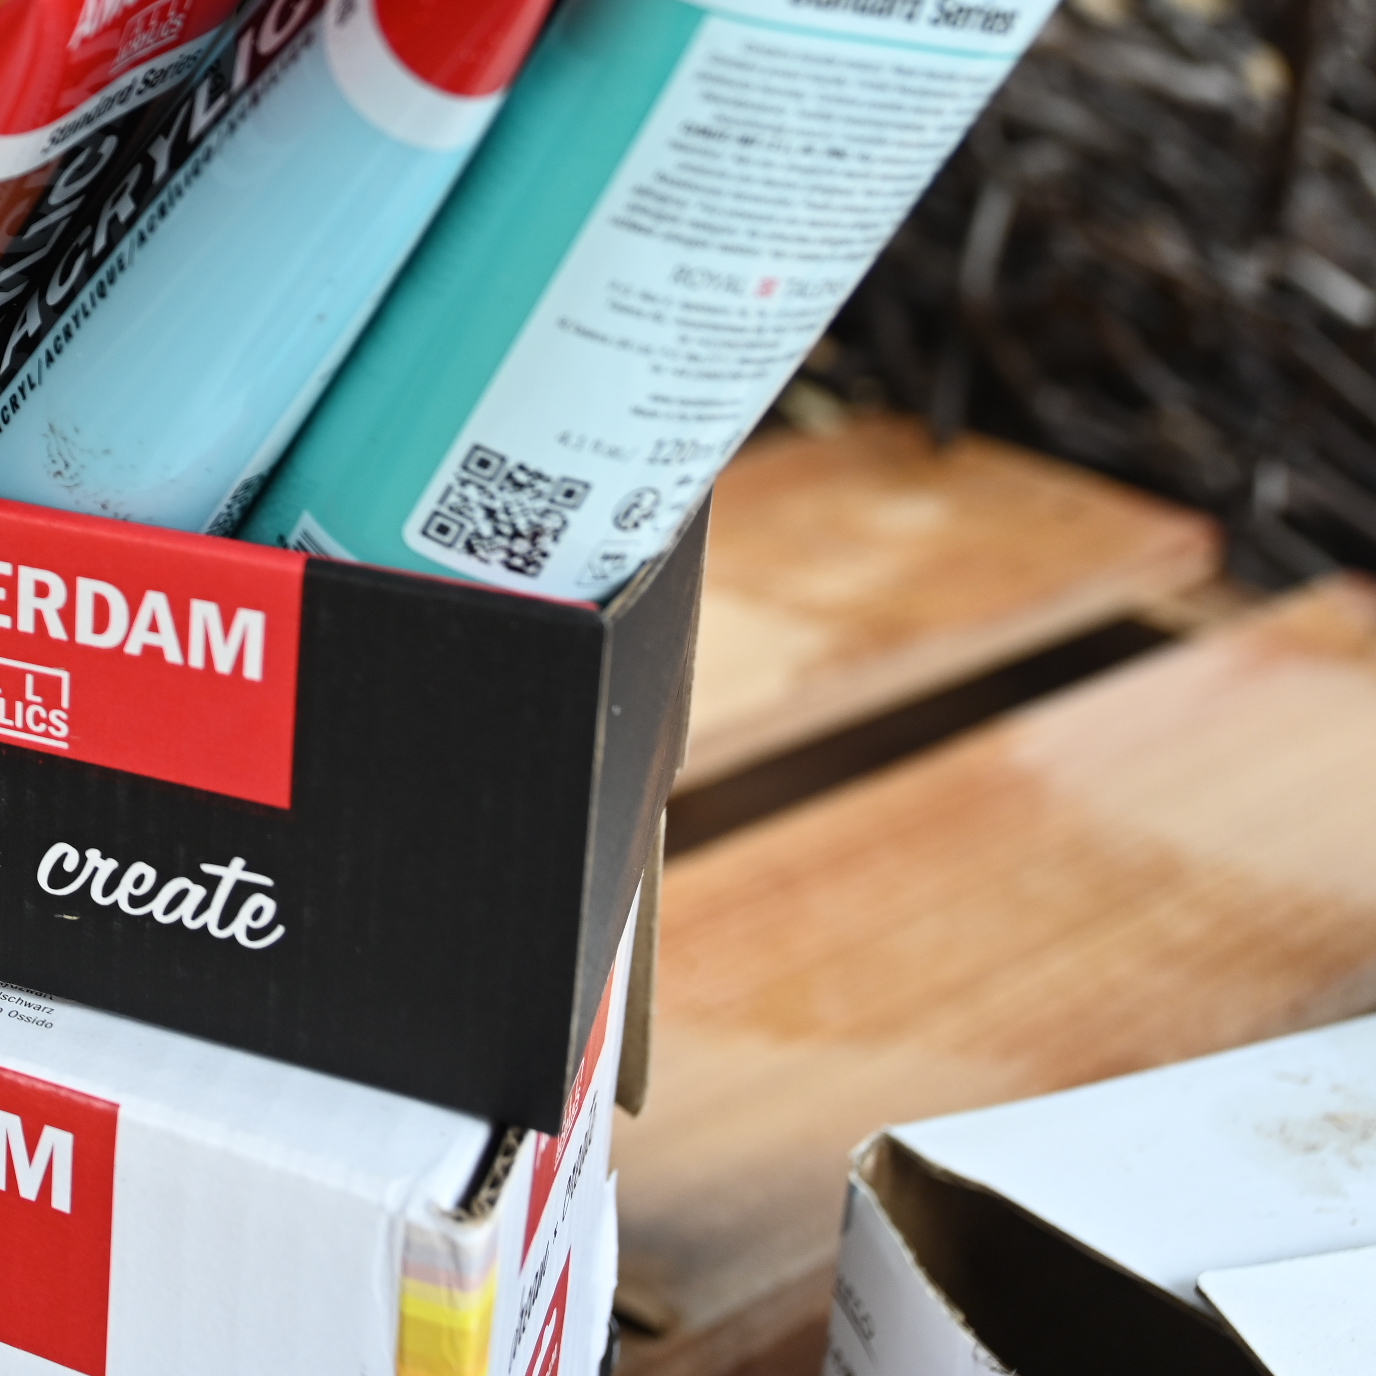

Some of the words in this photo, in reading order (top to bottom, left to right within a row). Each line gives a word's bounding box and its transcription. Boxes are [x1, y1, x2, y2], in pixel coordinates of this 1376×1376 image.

[41, 80, 136, 153] Standard
[135, 48, 200, 97] Series
[36, 840, 287, 951] create
[7, 1008, 55, 1031] Ossido
